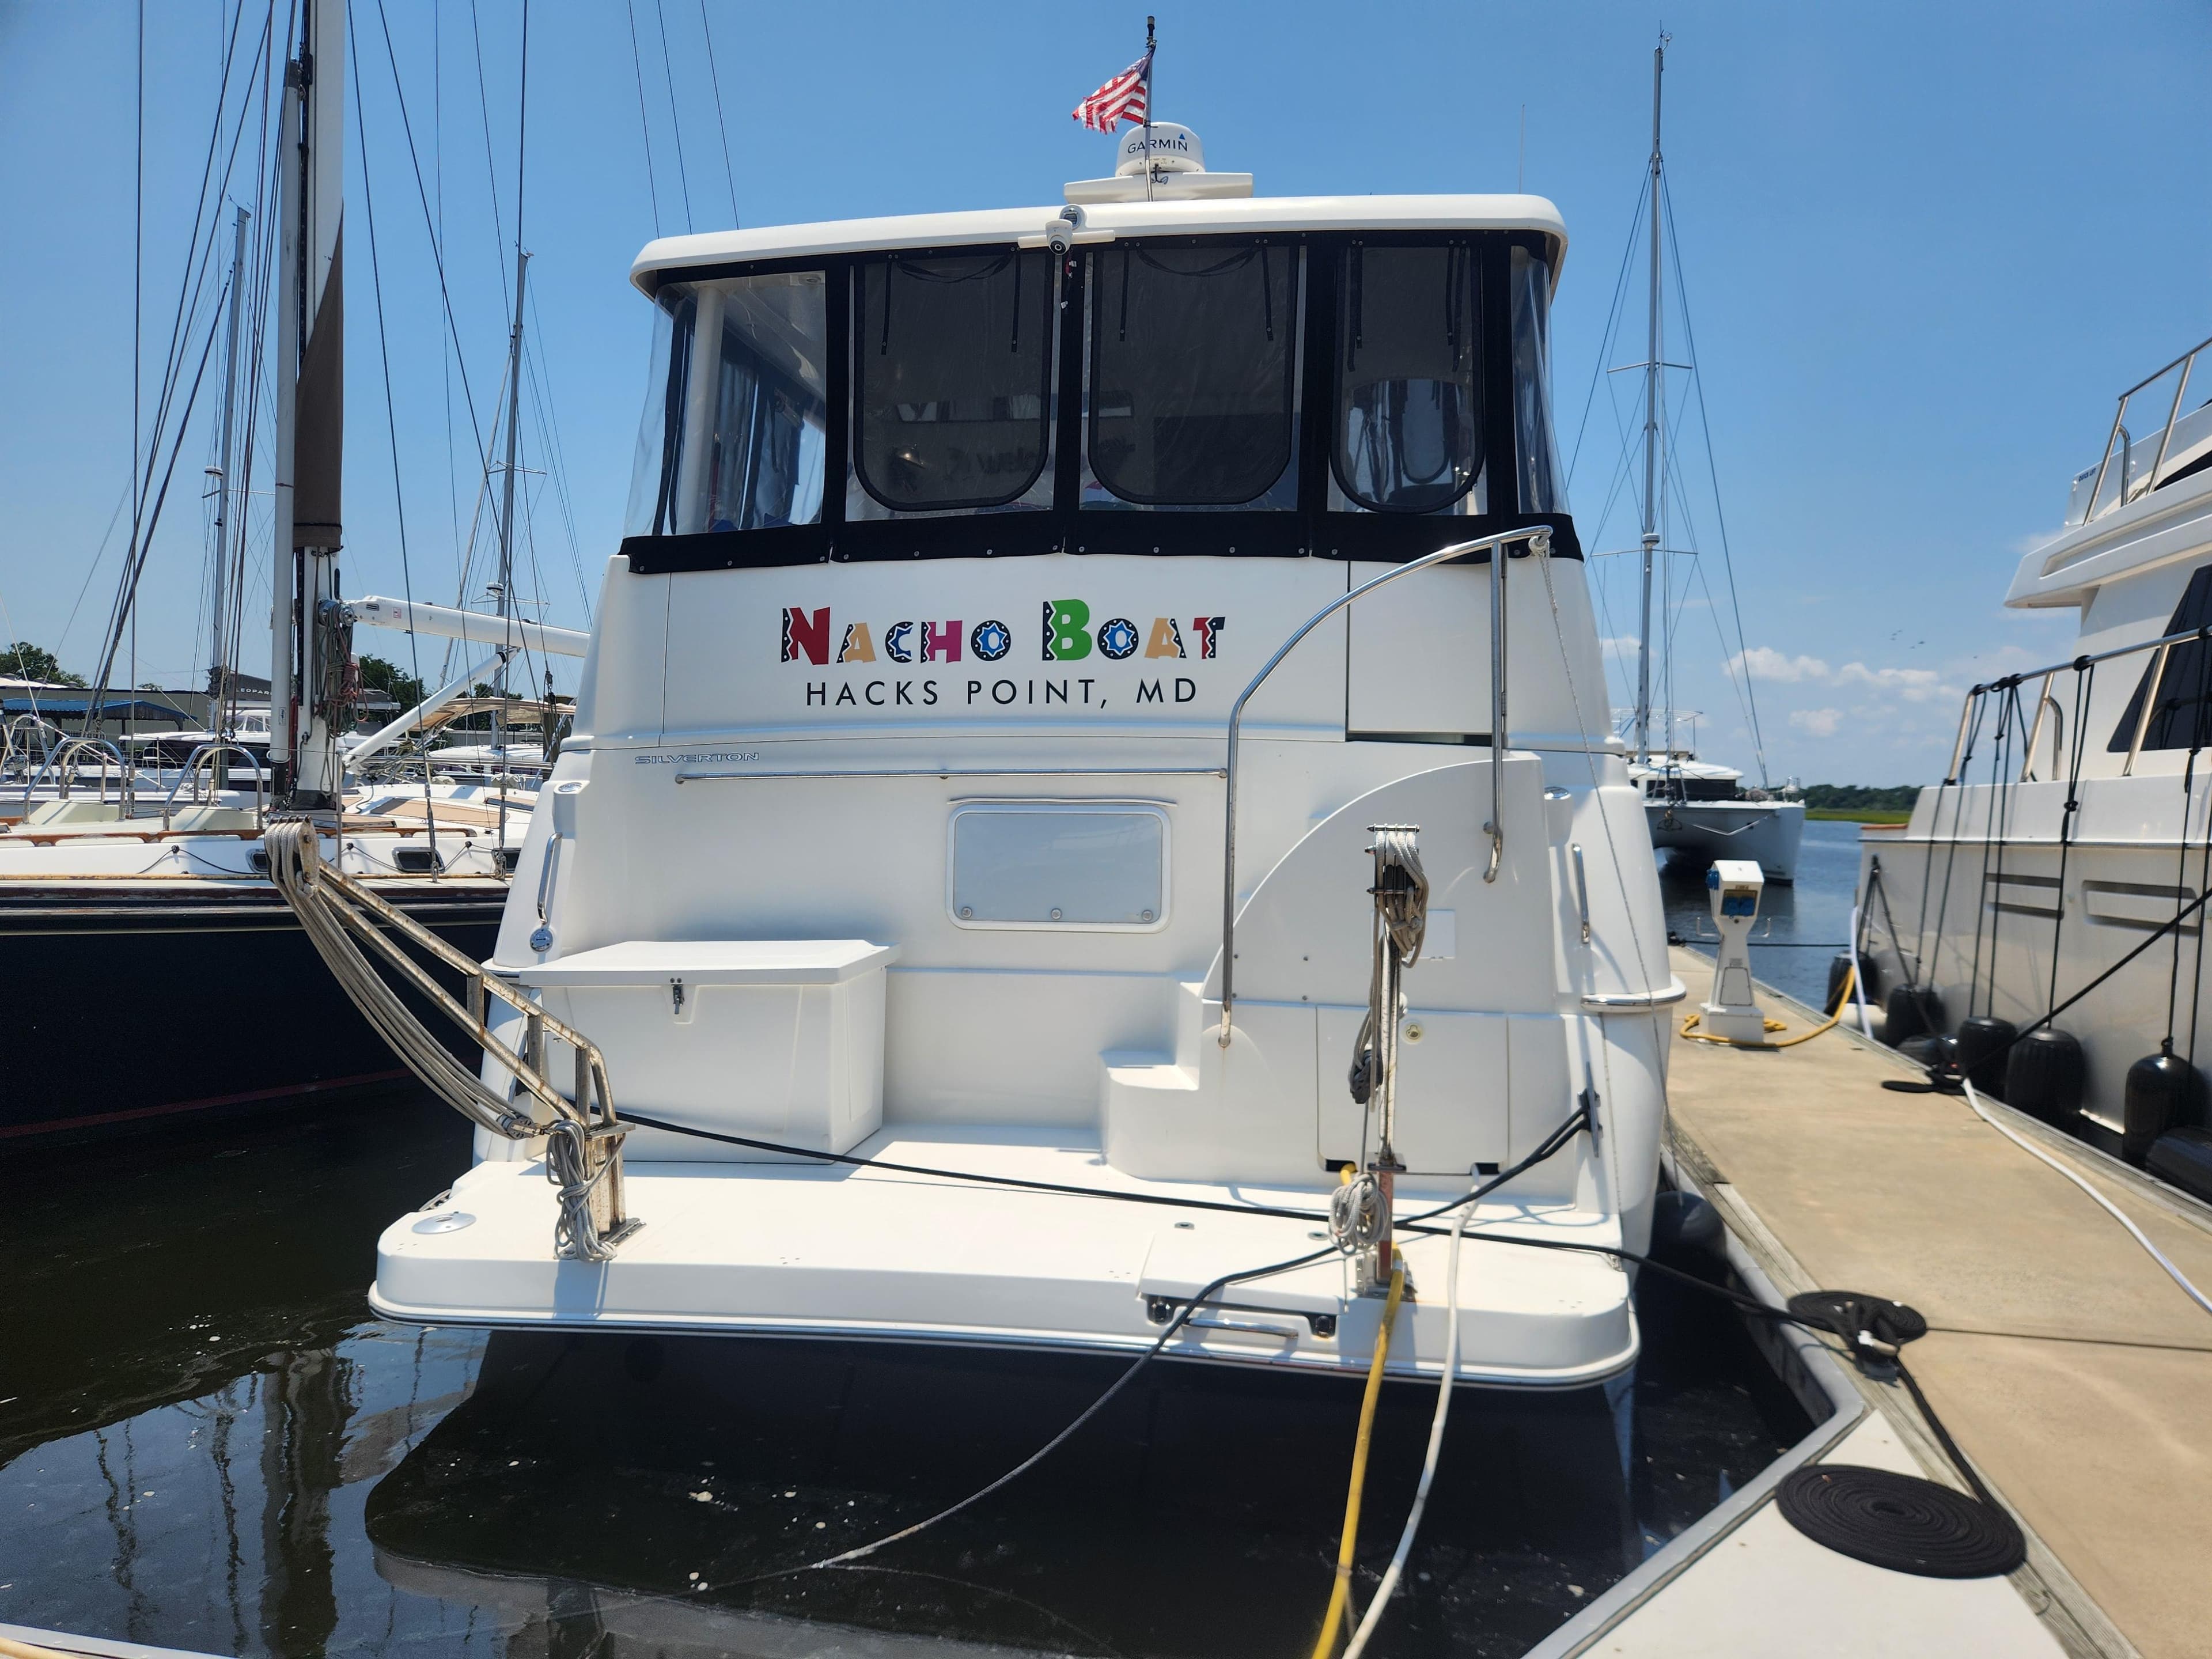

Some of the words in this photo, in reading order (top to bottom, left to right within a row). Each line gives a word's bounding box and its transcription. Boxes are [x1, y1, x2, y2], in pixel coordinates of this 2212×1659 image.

[1127, 139, 1188, 153] GARMIN
[807, 681, 938, 706] HACKS
[967, 679, 1108, 709] POINT,
[1136, 677, 1196, 703] MD
[635, 752, 759, 764] SILVERTON
